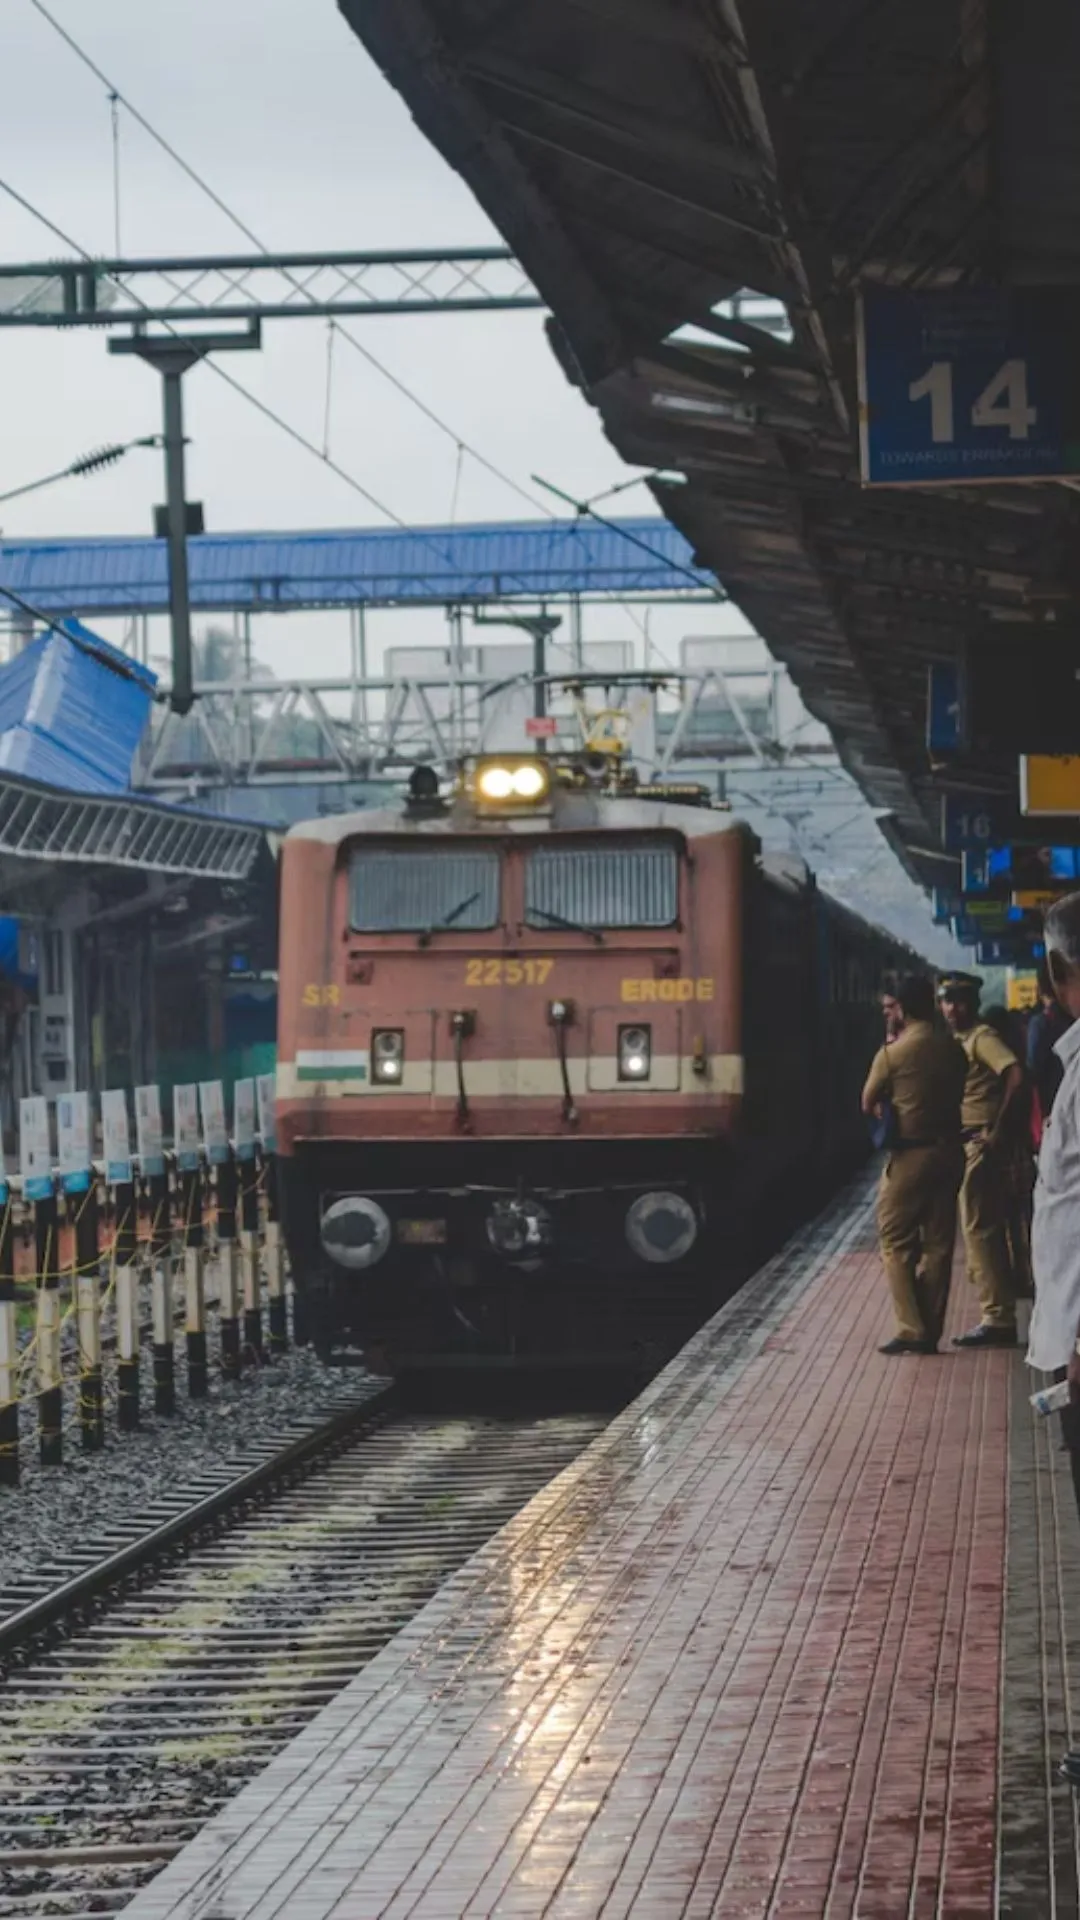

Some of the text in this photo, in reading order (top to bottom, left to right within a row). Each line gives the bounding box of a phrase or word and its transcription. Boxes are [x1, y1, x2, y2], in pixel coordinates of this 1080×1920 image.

[909, 360, 1037, 442] 14
[957, 813, 990, 838] 16
[465, 958, 555, 985] 22517
[302, 984, 340, 1007] SR
[621, 978, 714, 1003] ERODE
